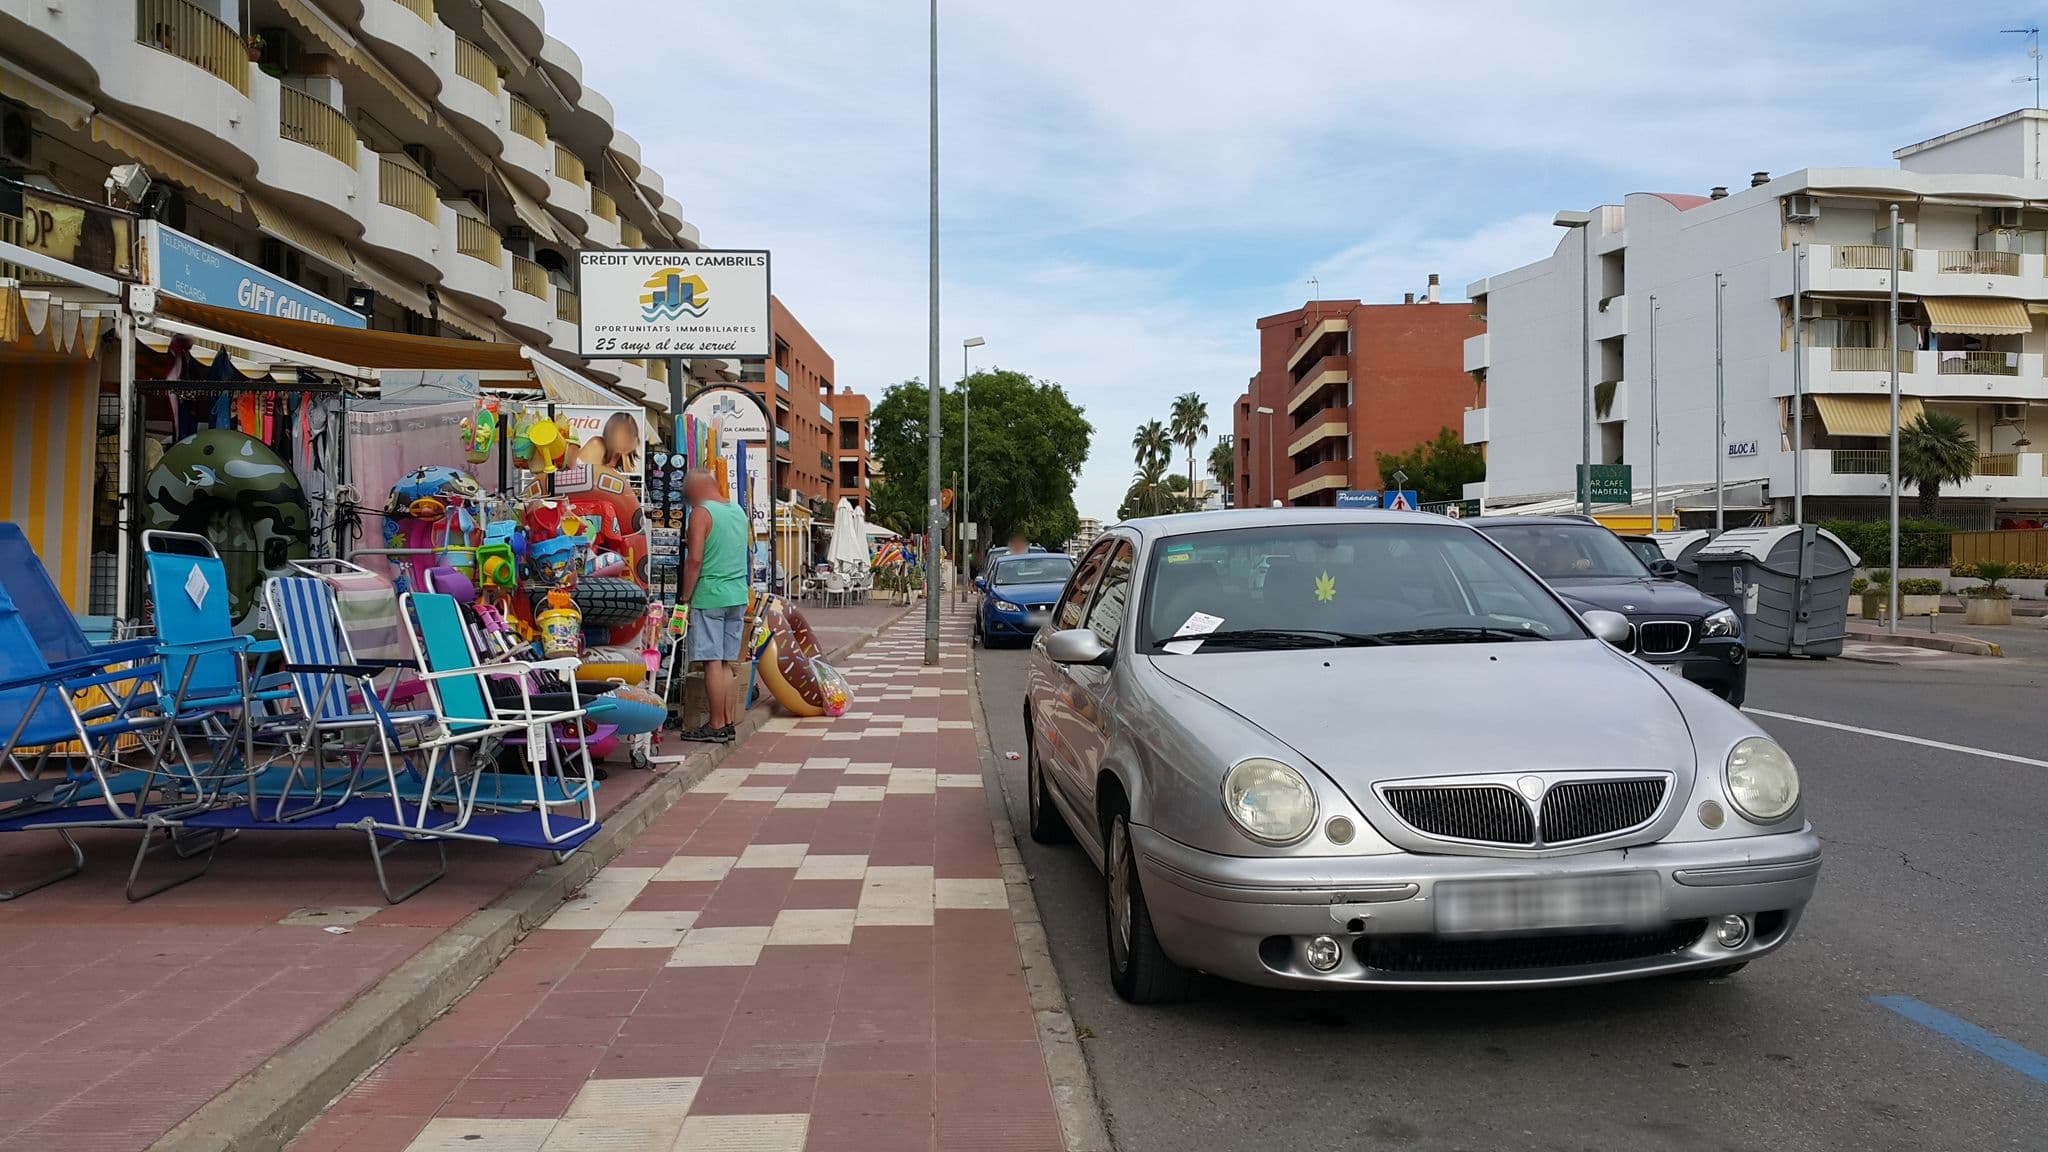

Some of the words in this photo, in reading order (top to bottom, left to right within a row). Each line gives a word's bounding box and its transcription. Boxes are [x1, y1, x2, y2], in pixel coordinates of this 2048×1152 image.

[161, 232, 200, 260] TELEPHONE
[202, 252, 220, 268] CARD
[581, 252, 628, 266] CRÈDIT
[633, 255, 690, 266] VIVENDA
[695, 256, 765, 267] CAMBRILS
[238, 278, 274, 315] GIFT
[595, 325, 671, 333] OPORTUNITATS
[676, 325, 756, 333] IMMOBILIARIES
[595, 338, 617, 351] 25
[620, 341, 651, 354] anys
[655, 338, 672, 350] al
[673, 342, 696, 351] seu
[699, 340, 737, 351] servei
[1728, 443, 1749, 455] BLOC
[1749, 442, 1756, 453] A
[1603, 479, 1624, 487] CAFE
[1581, 488, 1628, 496] NADERIA
